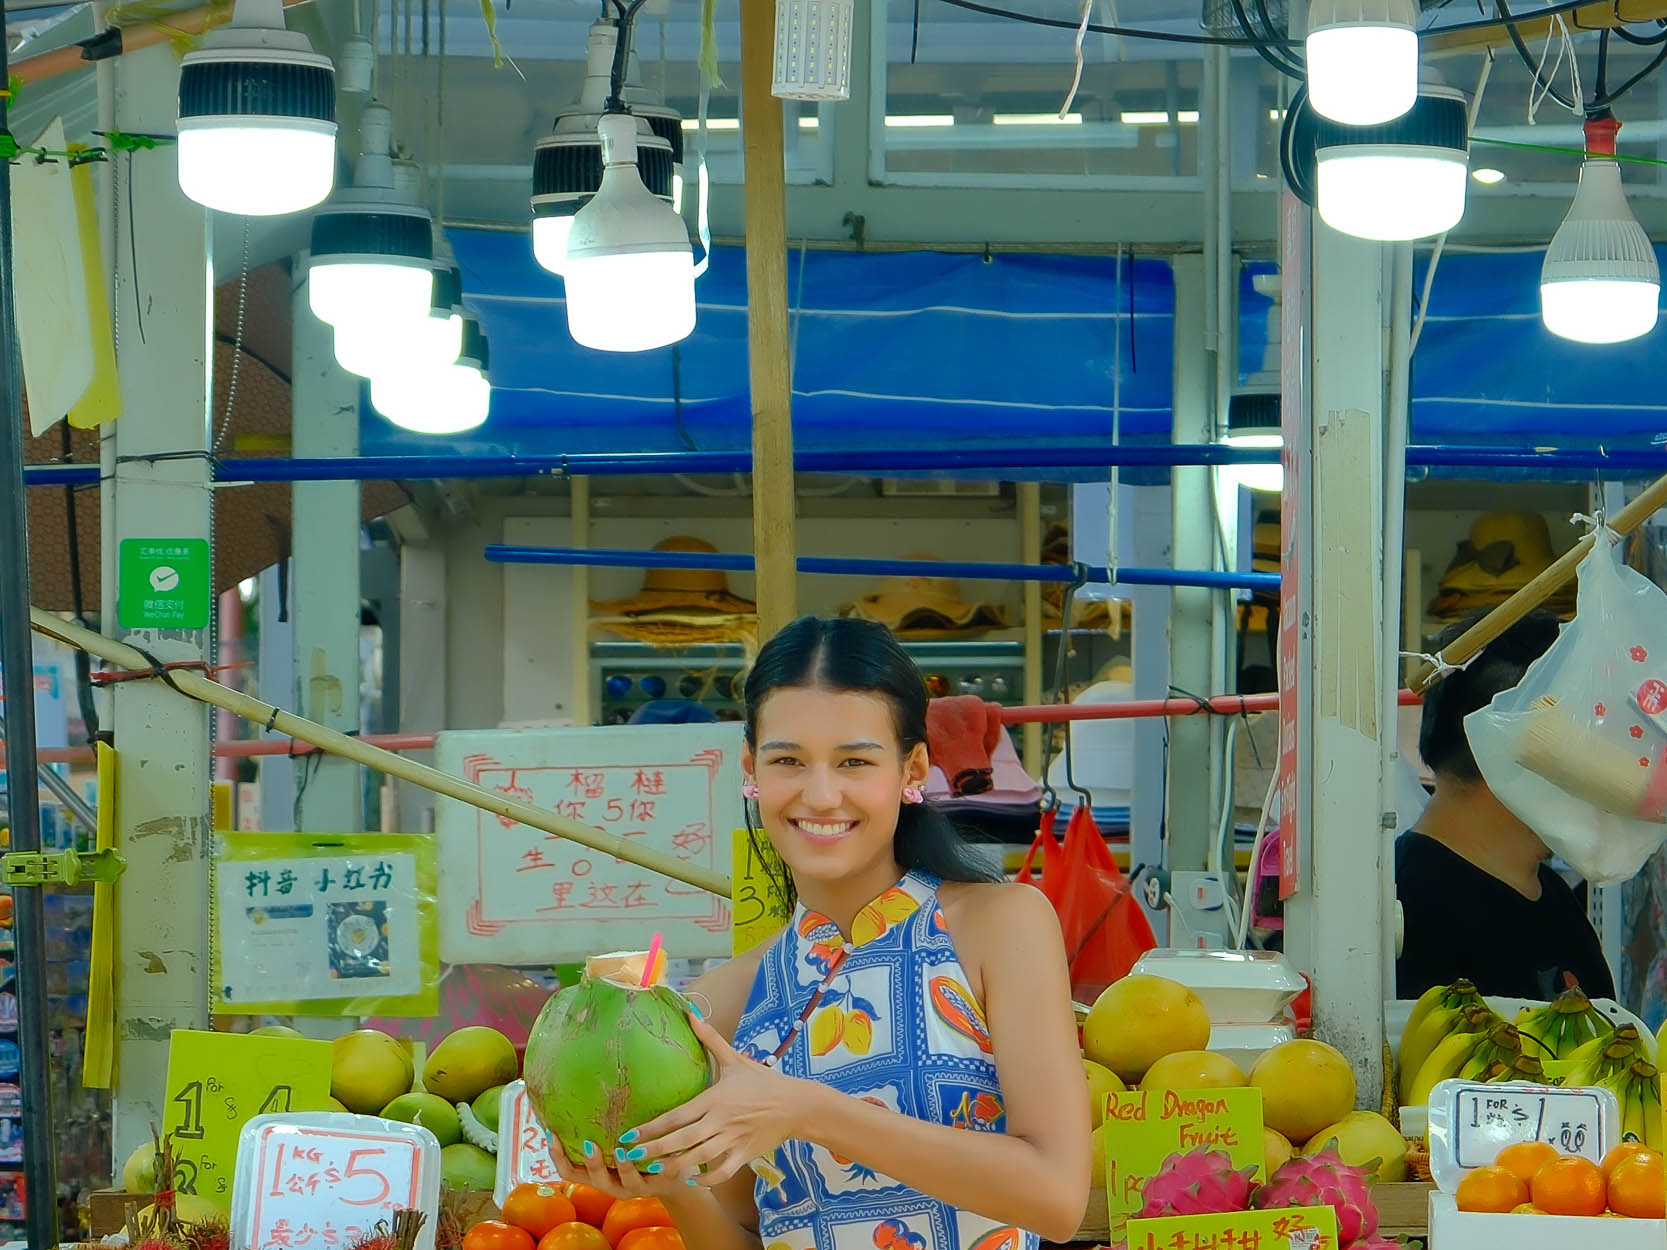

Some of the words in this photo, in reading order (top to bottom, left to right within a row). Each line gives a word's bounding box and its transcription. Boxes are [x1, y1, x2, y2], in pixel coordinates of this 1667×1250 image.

[244, 868, 298, 897] 抖音
[734, 886, 766, 926] 3
[173, 1080, 205, 1140] 1
[1105, 1090, 1148, 1121] Red
[1160, 1089, 1230, 1123] Dragon
[1470, 1097, 1481, 1128] 1
[1486, 1098, 1509, 1110] FOR
[1511, 1103, 1530, 1127] $
[1179, 1123, 1239, 1148] Fruit
[270, 1143, 286, 1197] 1
[292, 1145, 323, 1164] KG
[323, 1160, 342, 1190] $
[338, 1148, 391, 1206] 5
